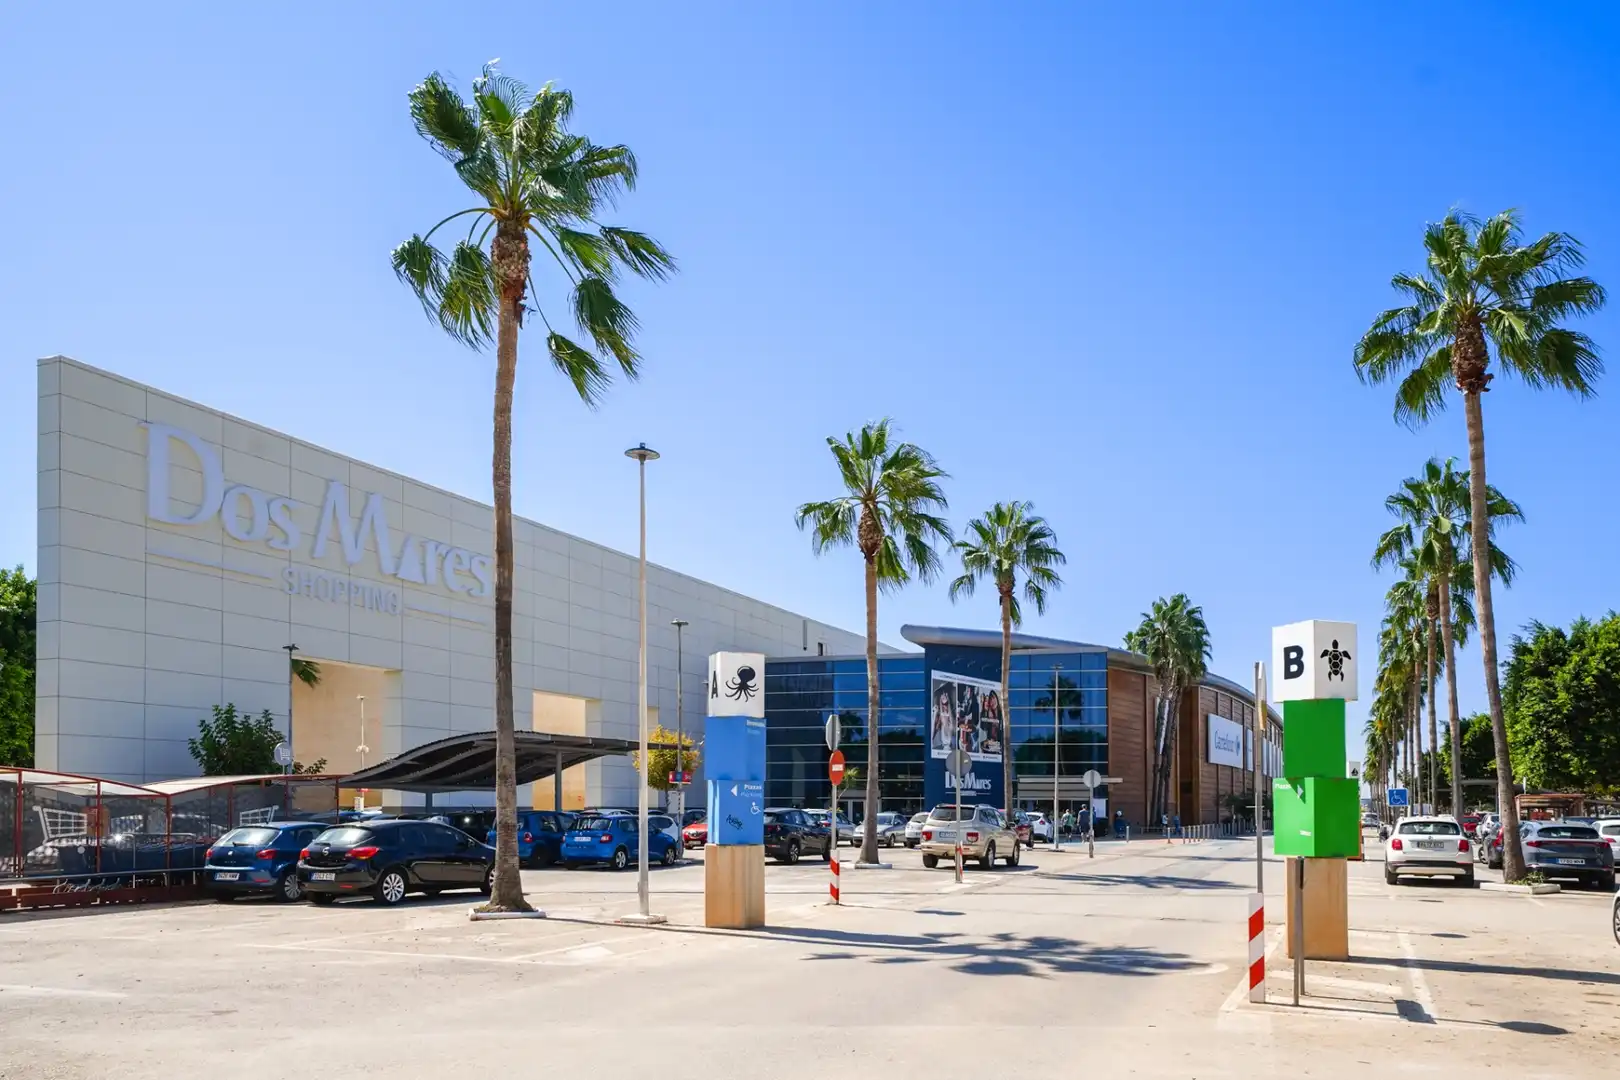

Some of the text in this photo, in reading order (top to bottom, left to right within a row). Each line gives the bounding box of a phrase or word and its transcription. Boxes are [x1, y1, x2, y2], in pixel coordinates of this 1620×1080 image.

[138, 421, 494, 600] Dos Mares
[281, 566, 402, 617] SHOPPING
[1283, 645, 1304, 680] B
[711, 670, 718, 699] A
